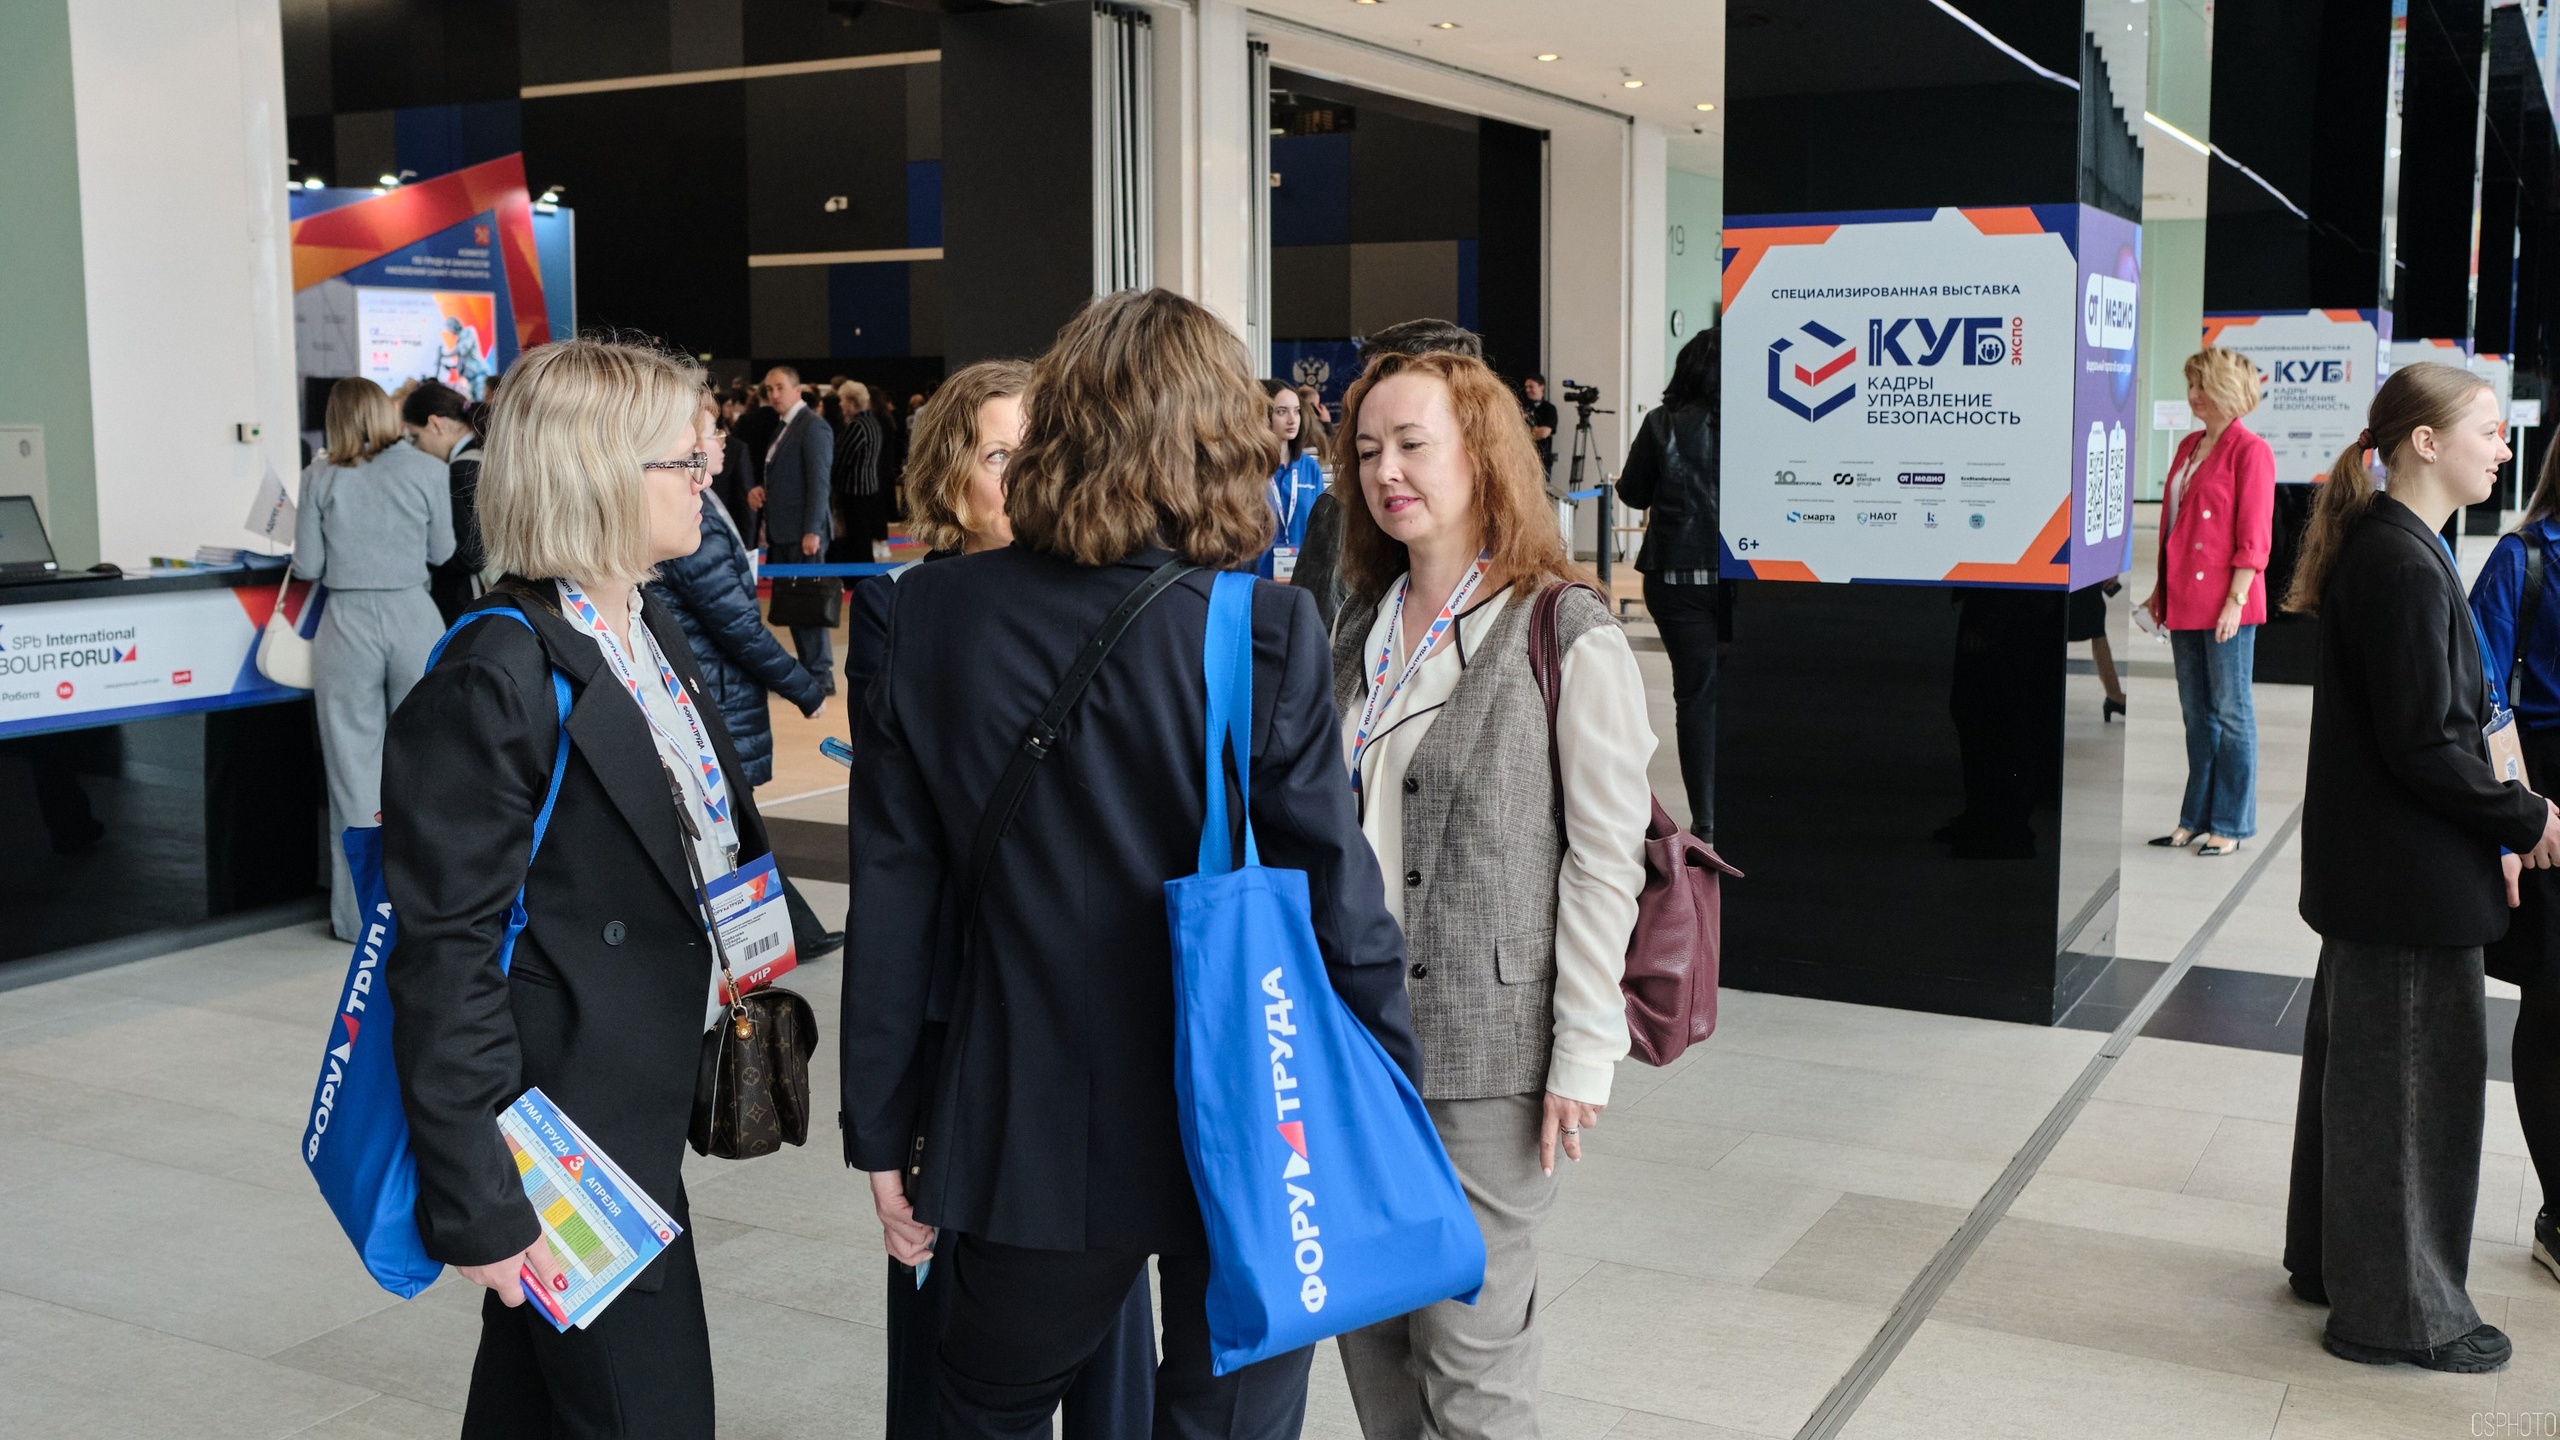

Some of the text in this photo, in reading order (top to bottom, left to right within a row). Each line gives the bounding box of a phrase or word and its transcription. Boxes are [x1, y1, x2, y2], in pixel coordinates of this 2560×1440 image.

[1668, 225, 1685, 256] 19
[1771, 284, 2021, 300] СПЕЦИАЛИЗИРОВАННАЯ ВЫСТАВКА
[1868, 317, 2006, 366] КУБ
[2011, 316, 2023, 366] ЭКСПО
[2274, 360, 2343, 383] КУБ
[1867, 376, 1934, 392] КАДРЫ
[2273, 387, 2308, 395] КАДРЫ
[1867, 393, 1993, 407] УПРАВЛЕНИЕ
[2273, 395, 2336, 403] УПРАВЛЕНИЕ
[1867, 411, 2021, 425] БЕЗОПАСНОСТЬ
[1802, 513, 1836, 522] смарта
[1869, 512, 1898, 521] НАОТ
[1738, 537, 1760, 551] 6+
[1463, 571, 1479, 590] ТРУДА
[12, 635, 41, 651] SPb
[46, 627, 136, 647] International
[2, 691, 40, 701] Работа
[749, 966, 772, 984] VIP
[1261, 966, 1301, 1121] ТРУДА
[541, 1120, 570, 1156] ТРУДА
[569, 1155, 585, 1171] 3
[585, 1176, 622, 1218] АПРЕЛЯ
